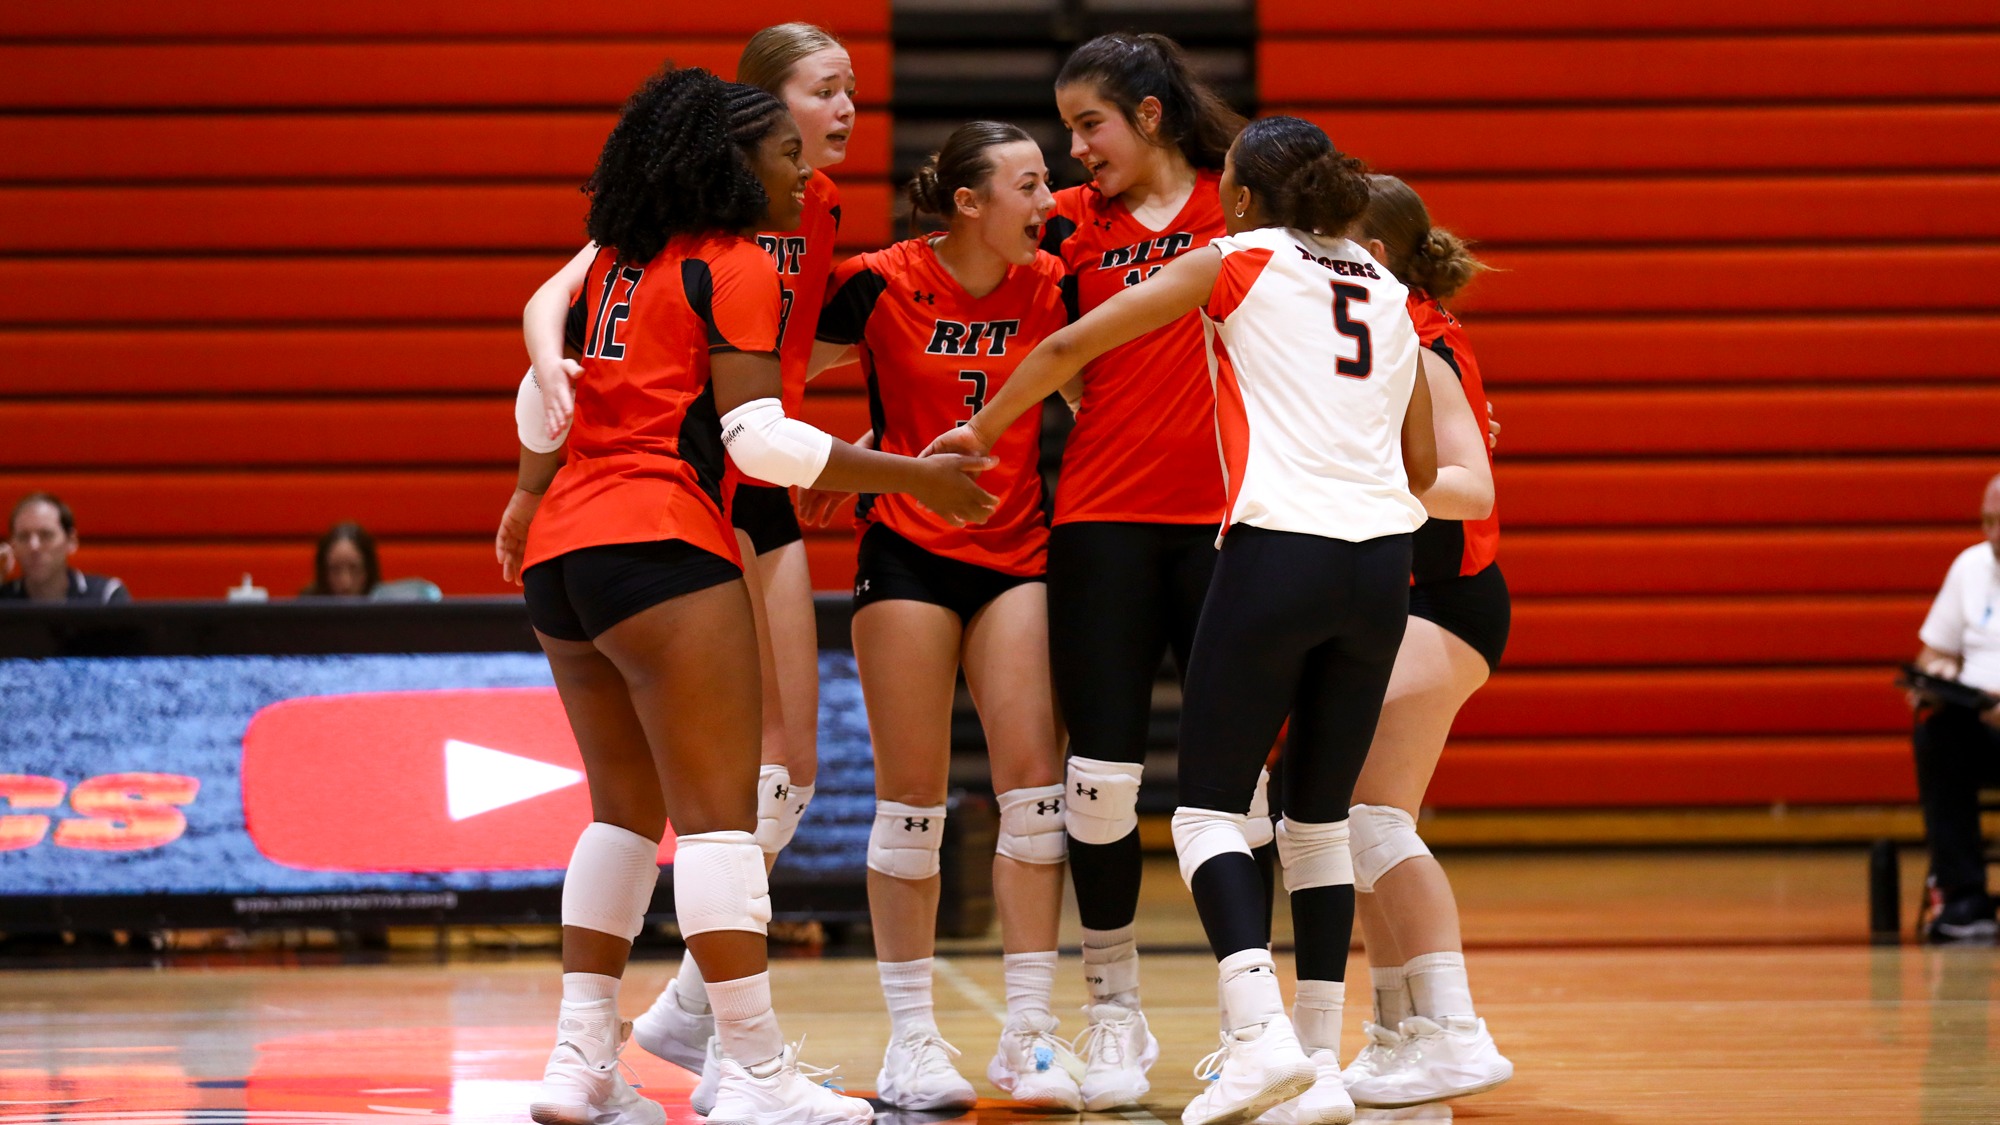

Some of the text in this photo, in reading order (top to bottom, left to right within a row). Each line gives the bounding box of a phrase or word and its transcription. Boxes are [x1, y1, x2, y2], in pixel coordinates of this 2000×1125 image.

[1098, 231, 1193, 270] RIT
[585, 261, 645, 361] 12
[925, 319, 1020, 356] RIT
[1329, 279, 1373, 380] 5
[956, 369, 988, 428] 3
